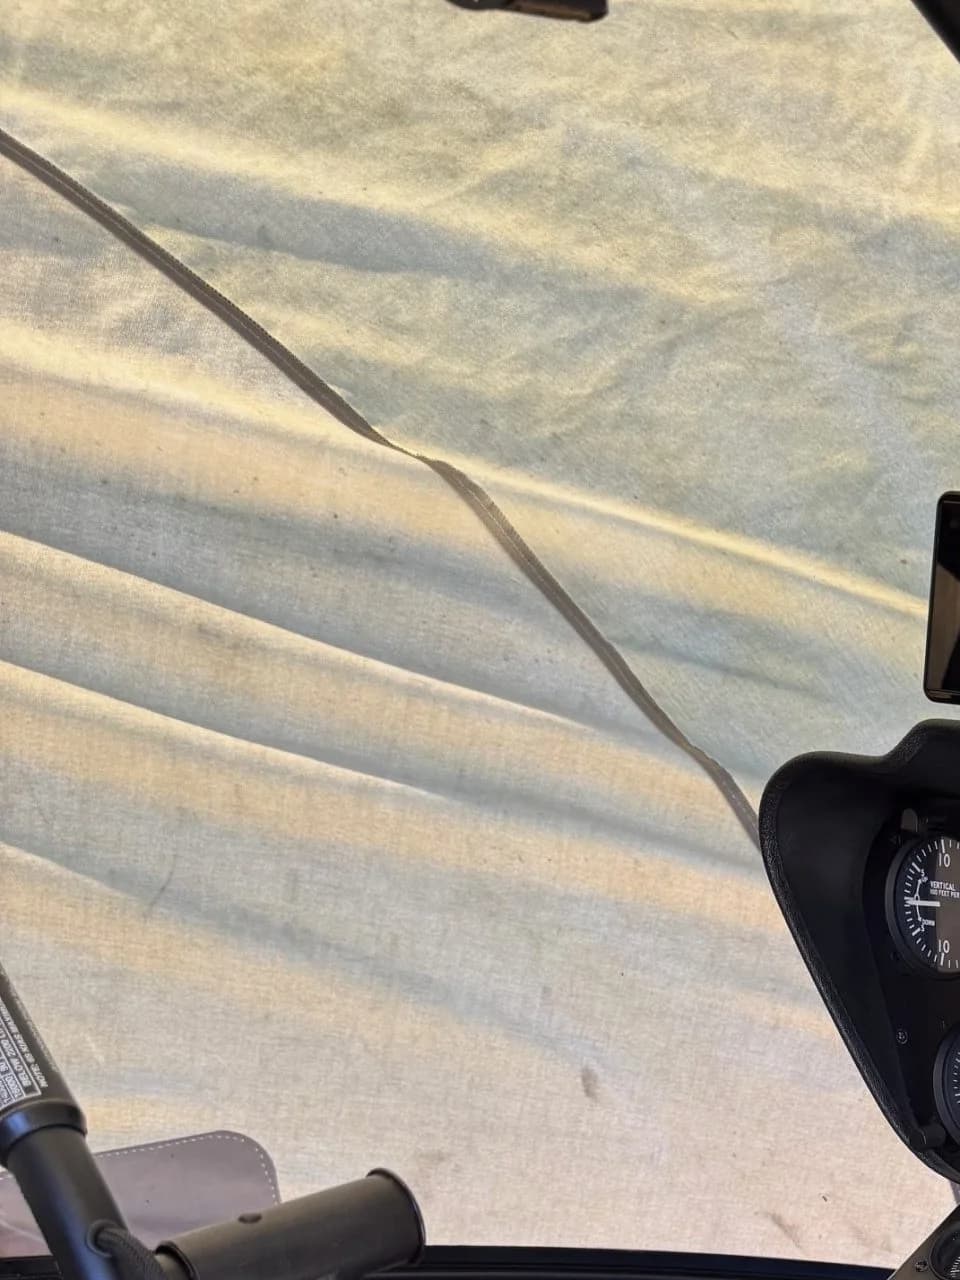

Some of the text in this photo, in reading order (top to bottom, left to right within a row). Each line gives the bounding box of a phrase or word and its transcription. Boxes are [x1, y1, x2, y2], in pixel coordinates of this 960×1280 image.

[939, 852, 951, 867] 10
[930, 881, 956, 891] VERTICAL
[938, 940, 950, 954] 10
[10, 1057, 32, 1087] BELOW
